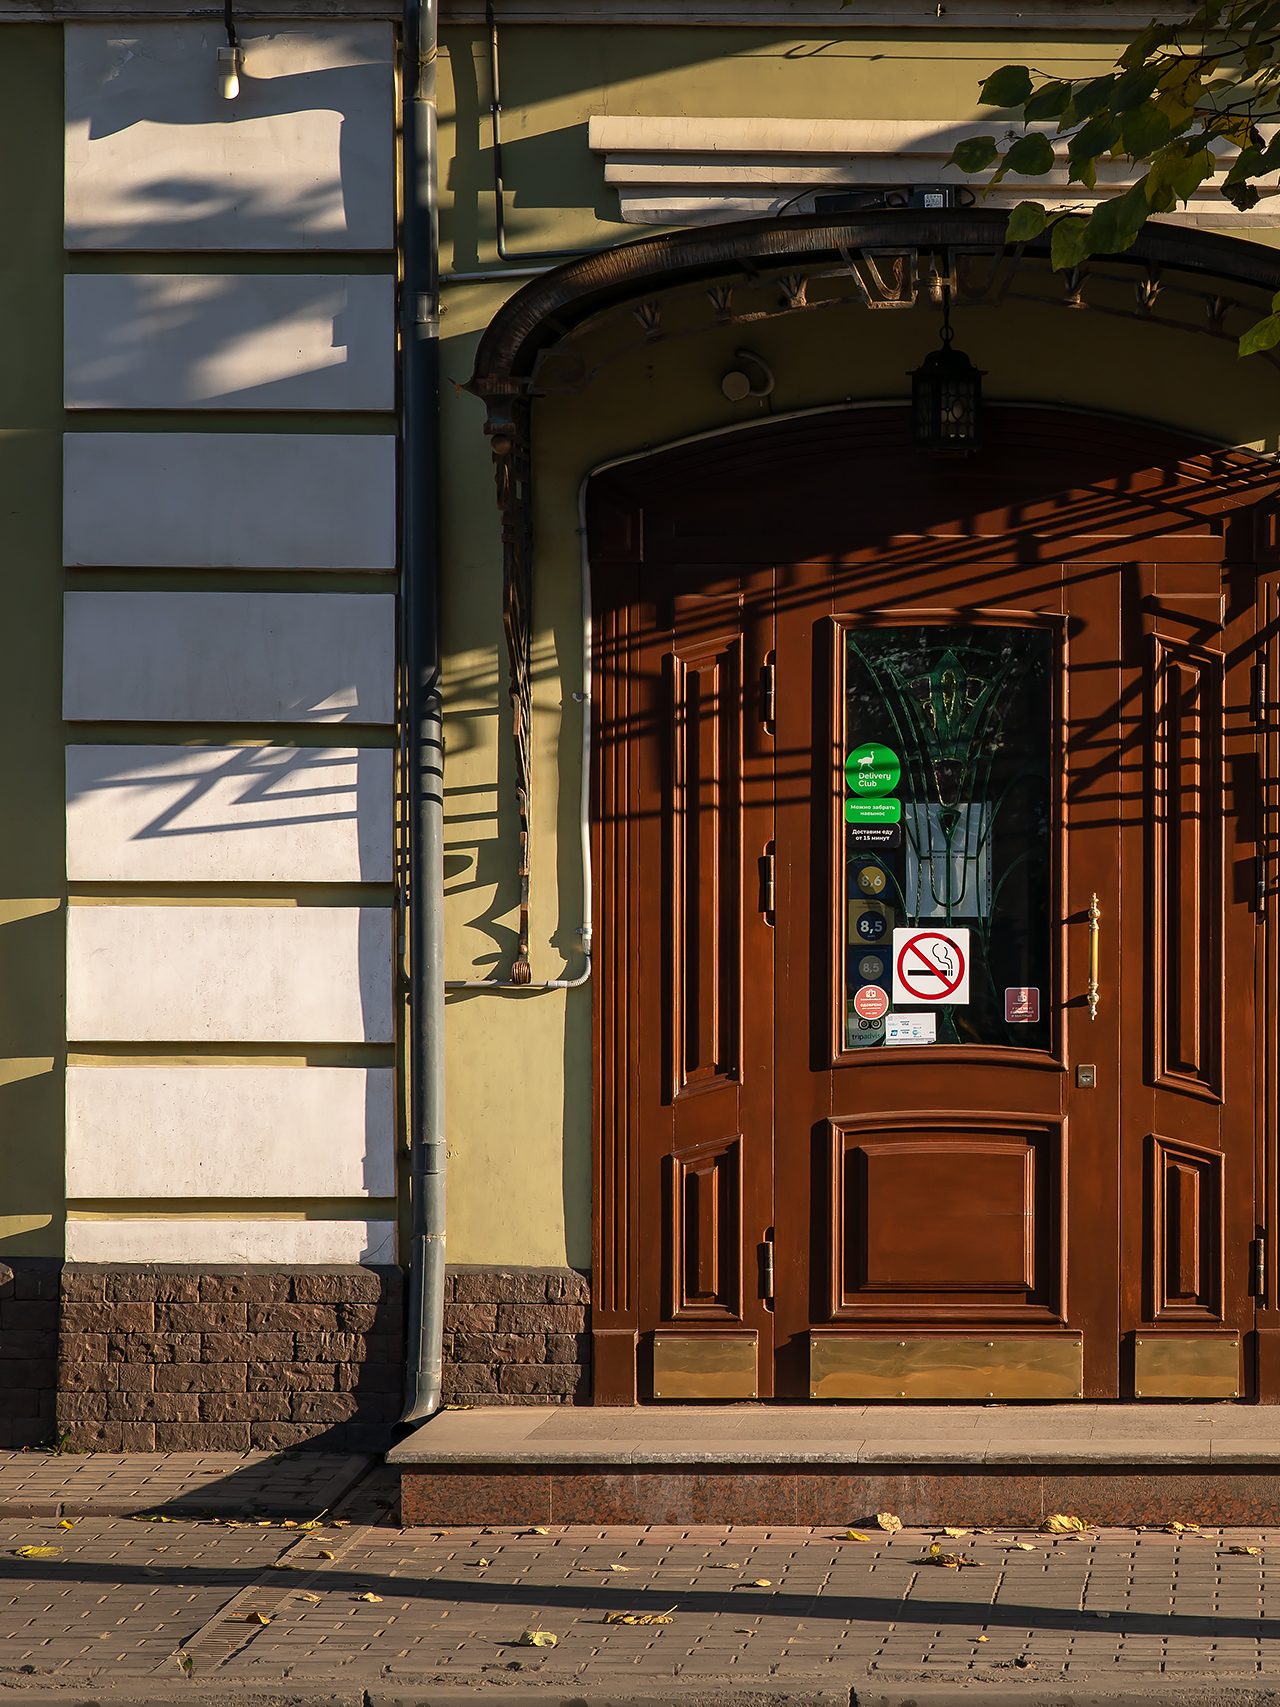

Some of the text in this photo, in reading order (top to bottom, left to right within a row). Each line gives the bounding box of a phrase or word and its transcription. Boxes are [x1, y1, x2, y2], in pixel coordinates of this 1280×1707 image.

[858, 772, 891, 781] Delivery
[861, 875, 882, 888] 8,6
[860, 920, 883, 934] 8,5
[862, 963, 880, 973] 8,5
